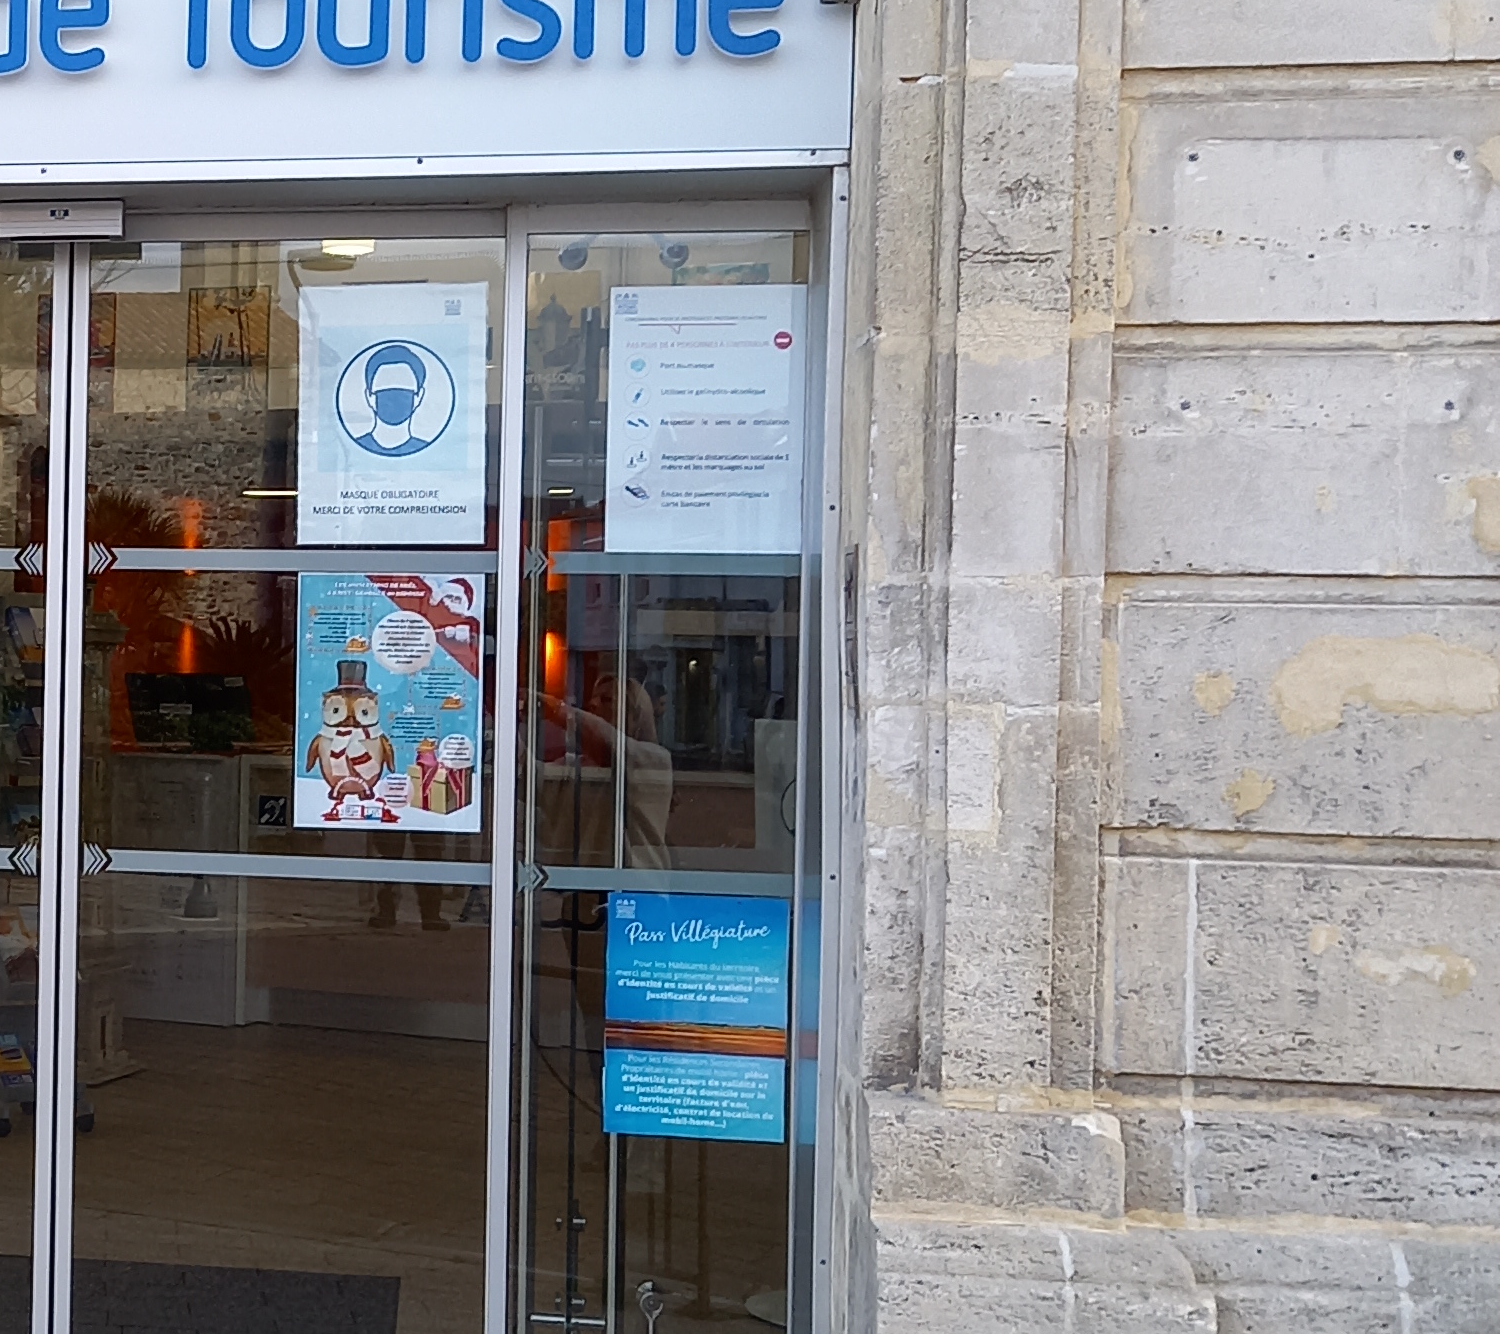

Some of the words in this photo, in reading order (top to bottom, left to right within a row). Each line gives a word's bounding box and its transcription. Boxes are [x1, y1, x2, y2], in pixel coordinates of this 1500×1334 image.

[340, 491, 378, 499] MASQUE
[381, 490, 439, 499] OBLIGATOIRE
[313, 505, 340, 514] MERCI
[343, 505, 354, 514] DE
[358, 505, 386, 514] VOTRE
[388, 505, 467, 514] COMPREHENSION
[625, 921, 666, 945] Pass
[671, 919, 771, 949] Villégiature
